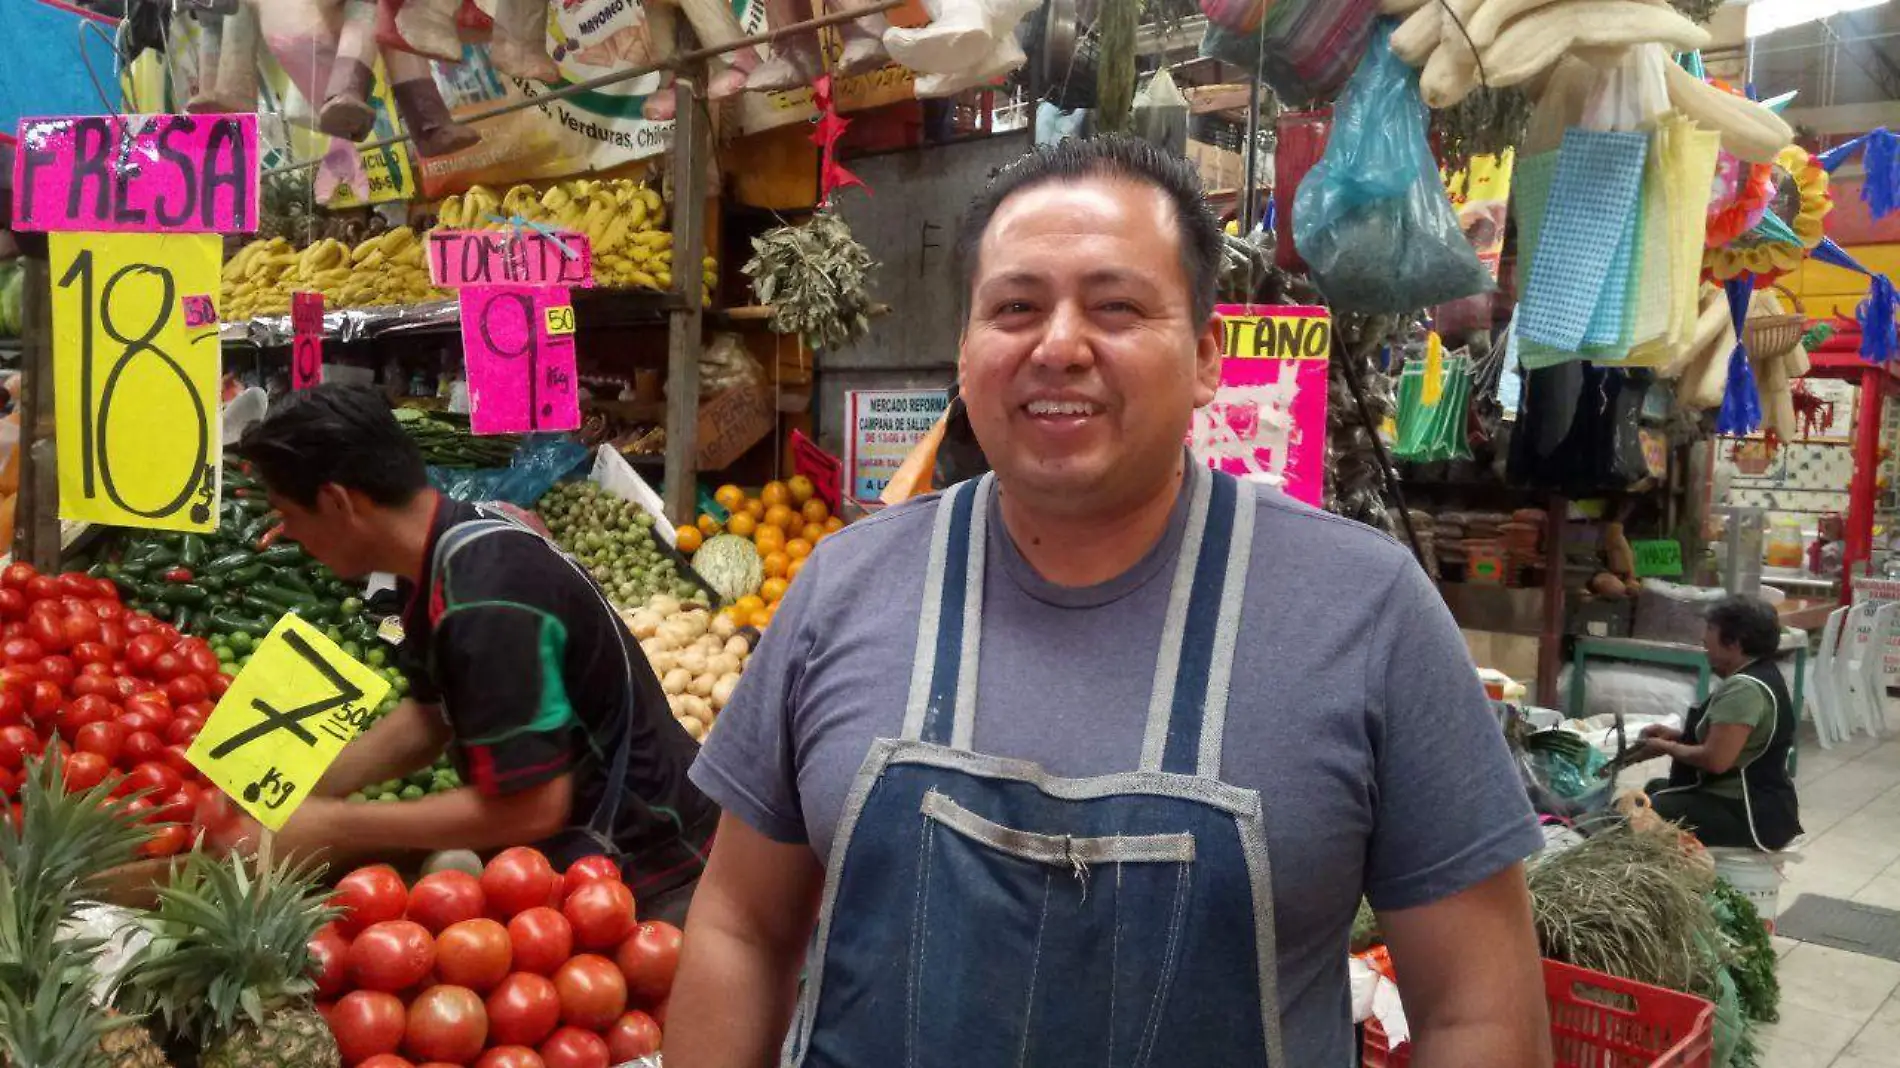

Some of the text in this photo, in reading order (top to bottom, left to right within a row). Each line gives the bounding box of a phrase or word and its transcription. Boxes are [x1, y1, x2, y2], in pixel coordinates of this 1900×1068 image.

[557, 105, 633, 149] Verduras,
[20, 116, 248, 230] FRESA
[430, 233, 584, 283] TOMATE
[479, 291, 574, 429] 9 50
[1223, 316, 1329, 358] TANO
[57, 249, 208, 518] 18
[870, 398, 947, 412] MERCADO REFORMA
[208, 628, 365, 760] 7
